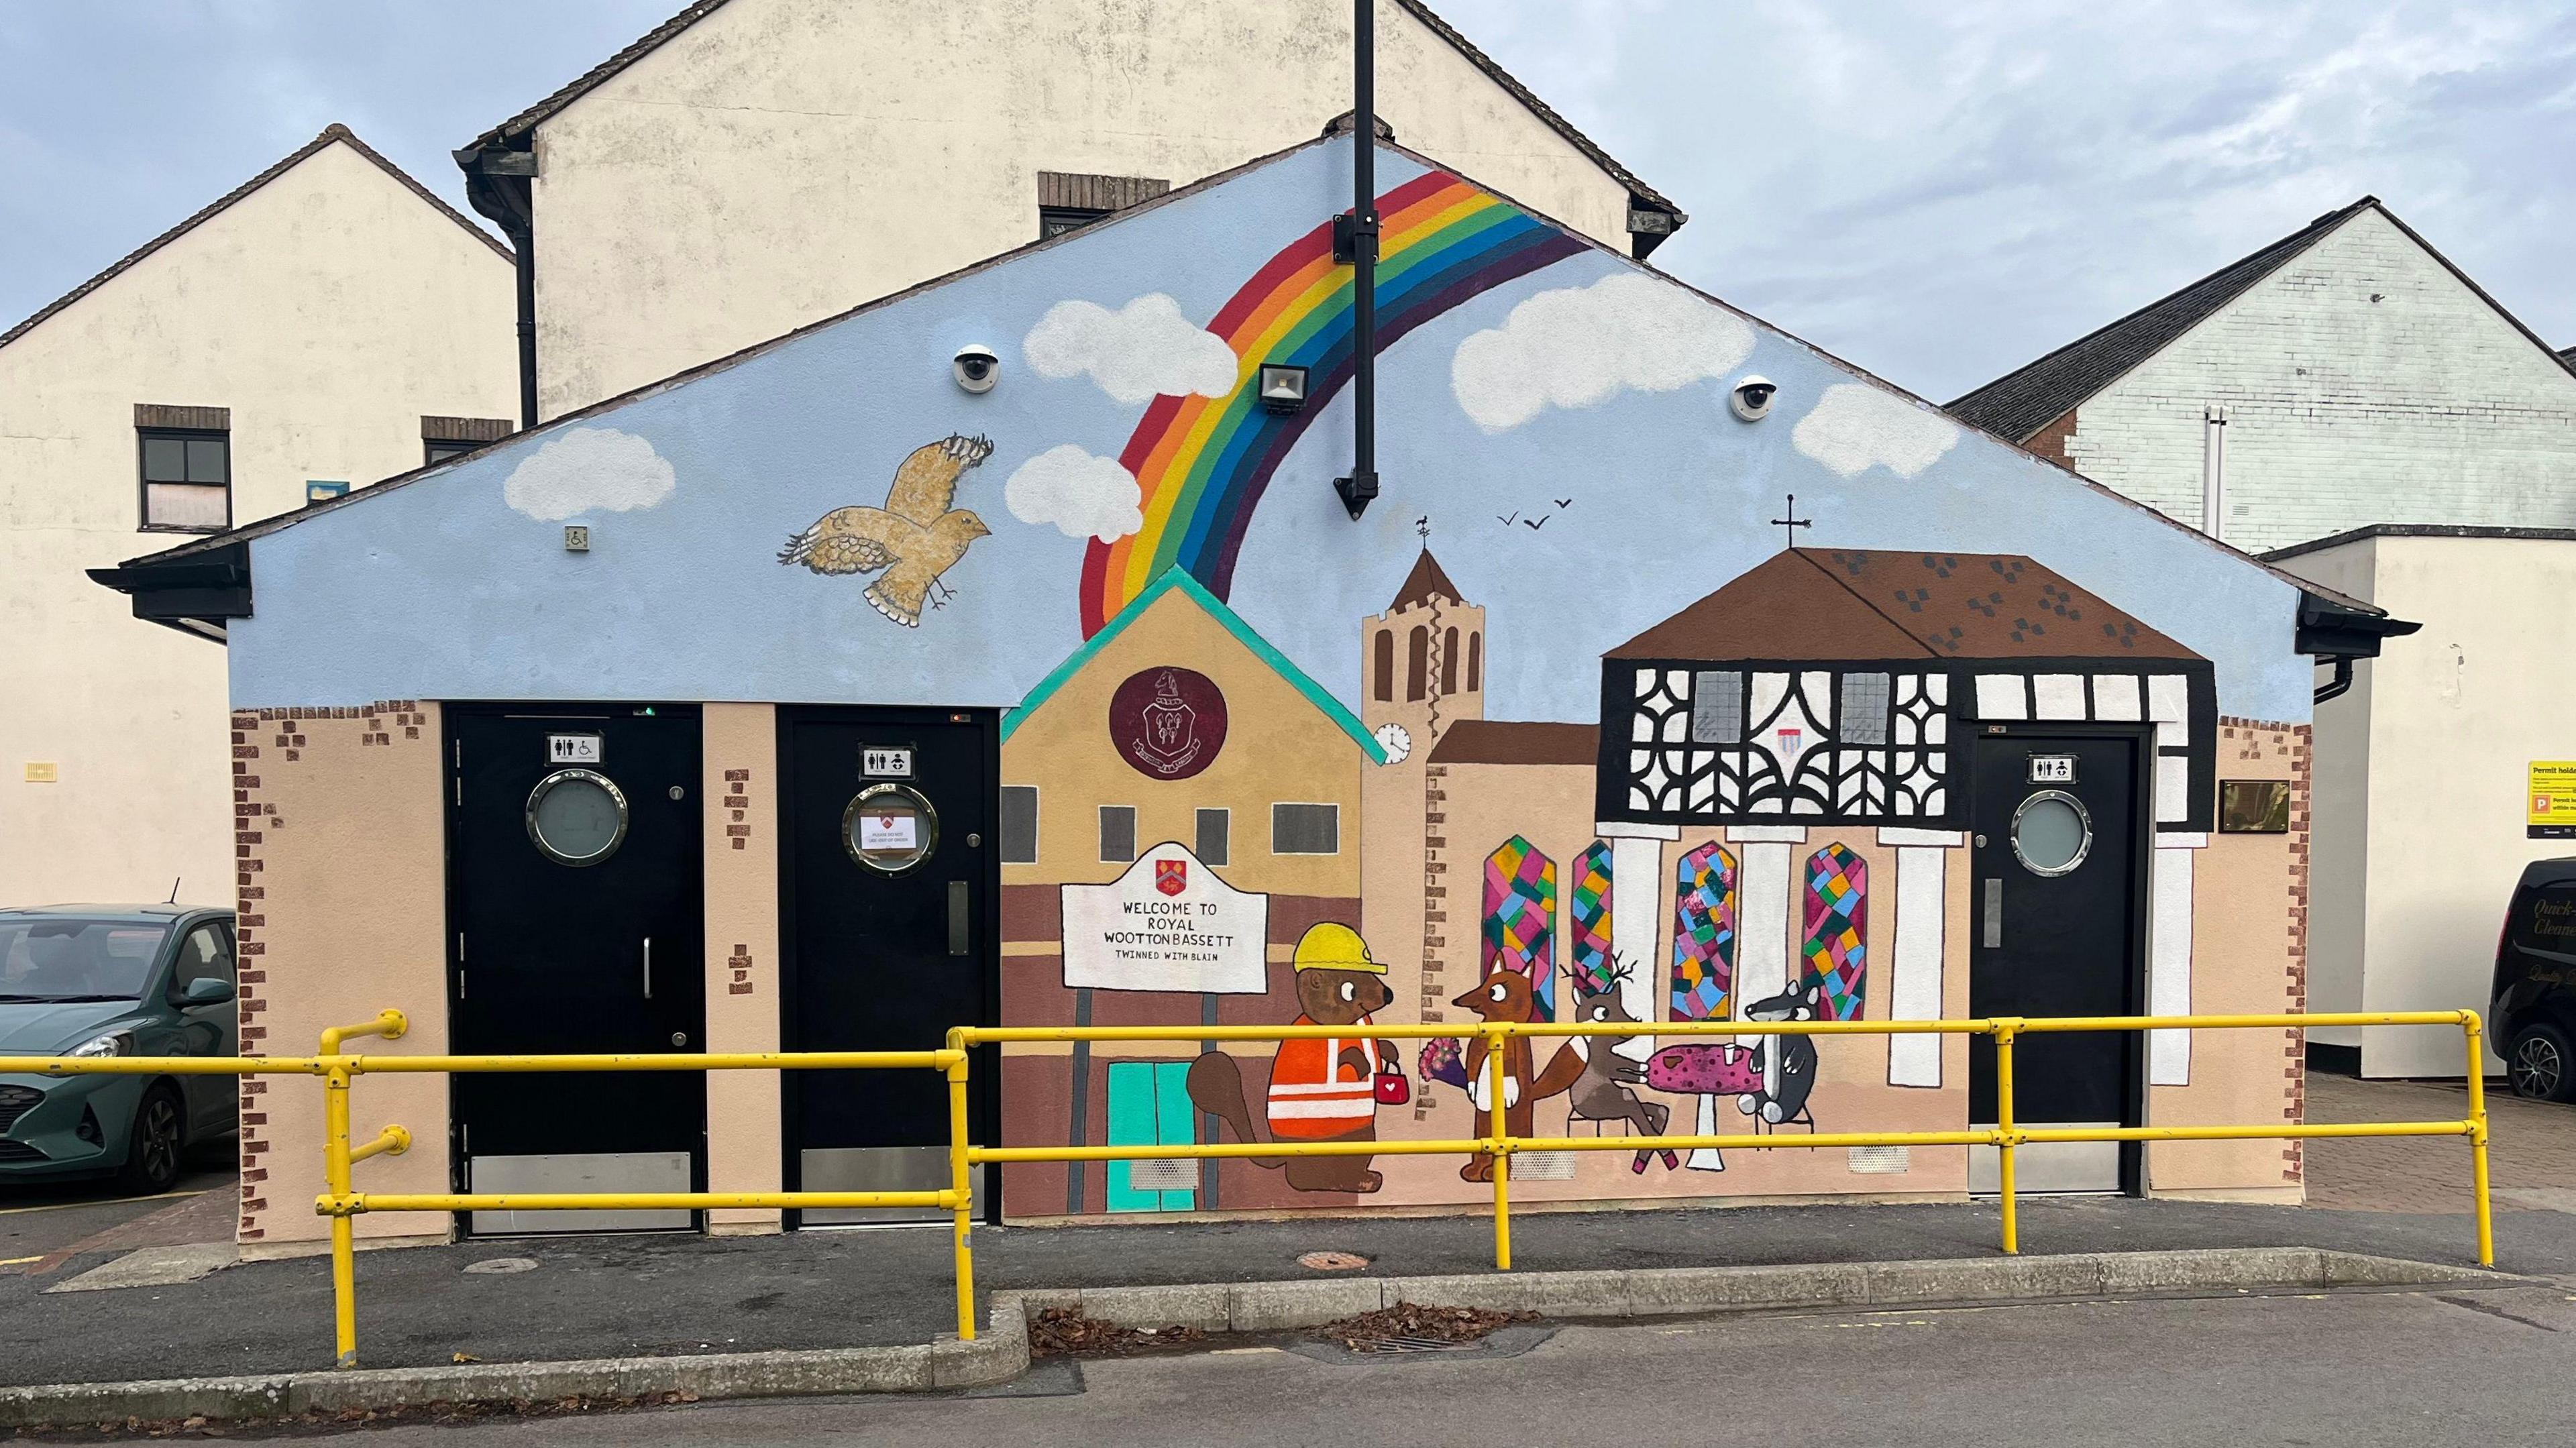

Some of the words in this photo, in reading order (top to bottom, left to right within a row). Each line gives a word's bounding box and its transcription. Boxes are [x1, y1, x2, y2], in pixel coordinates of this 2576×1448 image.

[2537, 799, 2546, 810] P
[1124, 902, 1191, 915] WELCOME
[1199, 903, 1217, 915] TO
[2534, 899, 2576, 918] Quick-
[1148, 917, 1195, 931] ROYAL
[1104, 932, 1170, 945] WOOTTON
[1173, 934, 1234, 947] BASSETT
[1116, 950, 1159, 960] TWINNED
[1165, 952, 1187, 960] WITH
[1191, 953, 1218, 961] BLAIN
